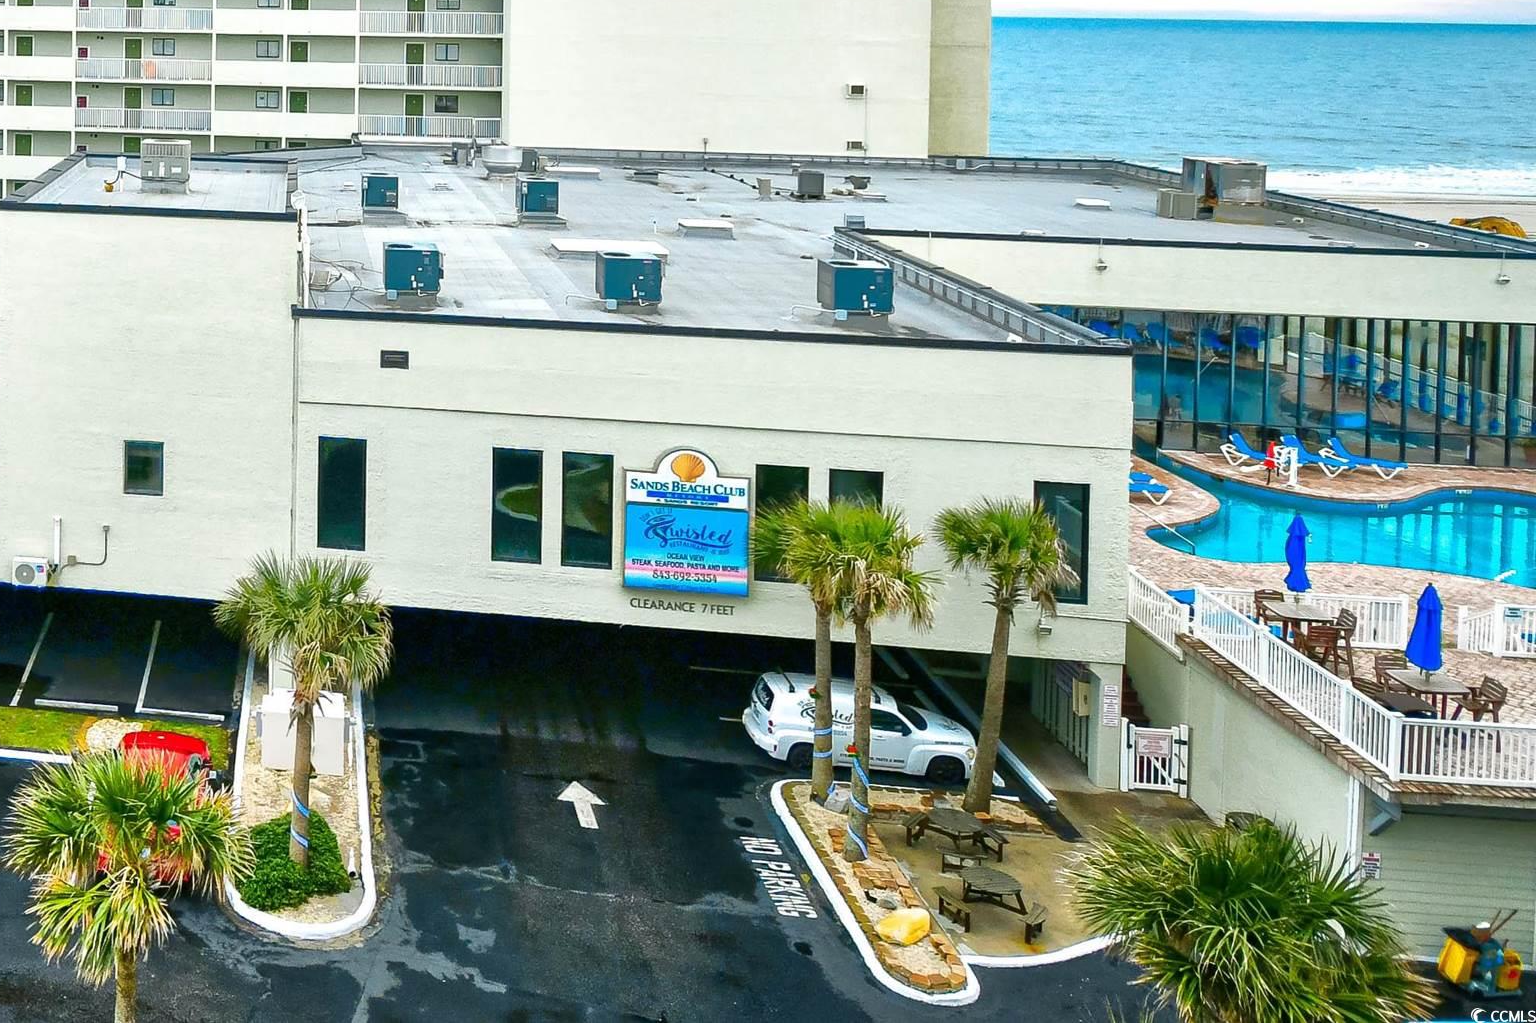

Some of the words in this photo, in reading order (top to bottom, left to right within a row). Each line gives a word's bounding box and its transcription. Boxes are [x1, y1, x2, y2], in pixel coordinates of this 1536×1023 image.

[630, 478, 670, 491] SANDS
[672, 481, 711, 494] BEACH
[713, 484, 746, 497] CLUB
[644, 515, 734, 548] Twisted
[686, 562, 707, 570] PASTA
[708, 564, 721, 572] AND
[722, 565, 740, 573] MORE
[630, 597, 696, 612] CLEARANCE
[701, 603, 708, 613] 7
[710, 604, 736, 616] FEET
[739, 836, 783, 856] NO
[752, 859, 818, 919] PARKING
